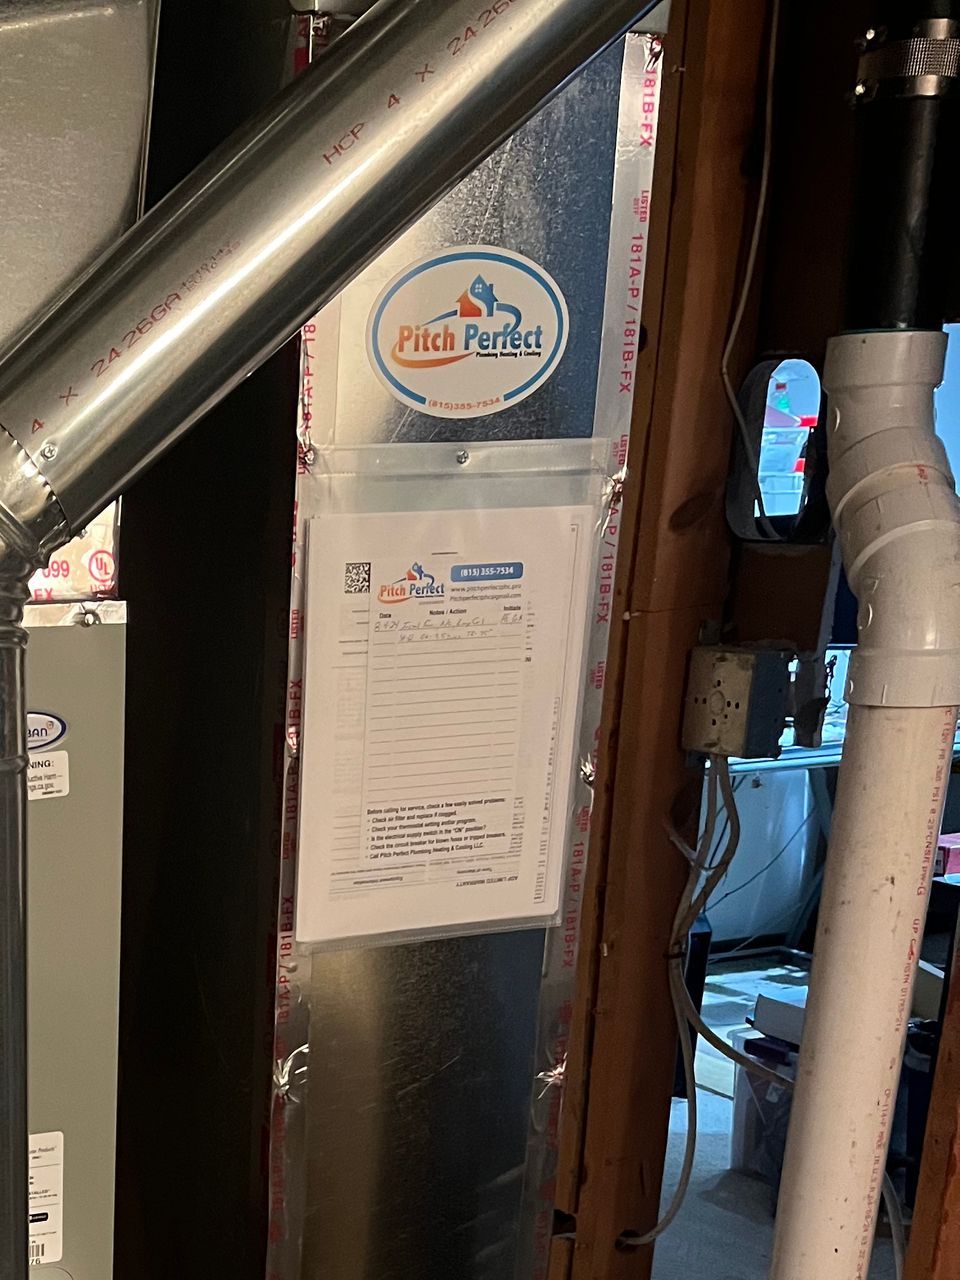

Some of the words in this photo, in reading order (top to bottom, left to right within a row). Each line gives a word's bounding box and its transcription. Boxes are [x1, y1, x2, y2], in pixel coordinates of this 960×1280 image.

[322, 121, 365, 165] HCP
[387, 93, 401, 110] 4
[446, 25, 478, 56] 24
[478, 0, 518, 27] 26
[639, 68, 657, 148] 181B-FX
[639, 189, 650, 223] LISTED
[628, 232, 644, 298] 181A-P
[30, 417, 45, 434] 4
[90, 346, 122, 379] 24
[122, 291, 182, 346] 26GA
[398, 324, 455, 353] Pitch
[464, 322, 543, 351] Perfect
[618, 318, 636, 394] 181B-FX
[618, 434, 628, 466] LISTED
[380, 584, 406, 598] Pitch
[409, 581, 445, 596] Perfect
[460, 567, 480, 578] (815)
[480, 566, 514, 576] 355-7534
[596, 553, 614, 625] 181B-FX
[595, 660, 606, 690] LISTED
[28, 760, 55, 770] NING:
[568, 841, 585, 893] 181A-P
[562, 908, 578, 968] 181B-FX
